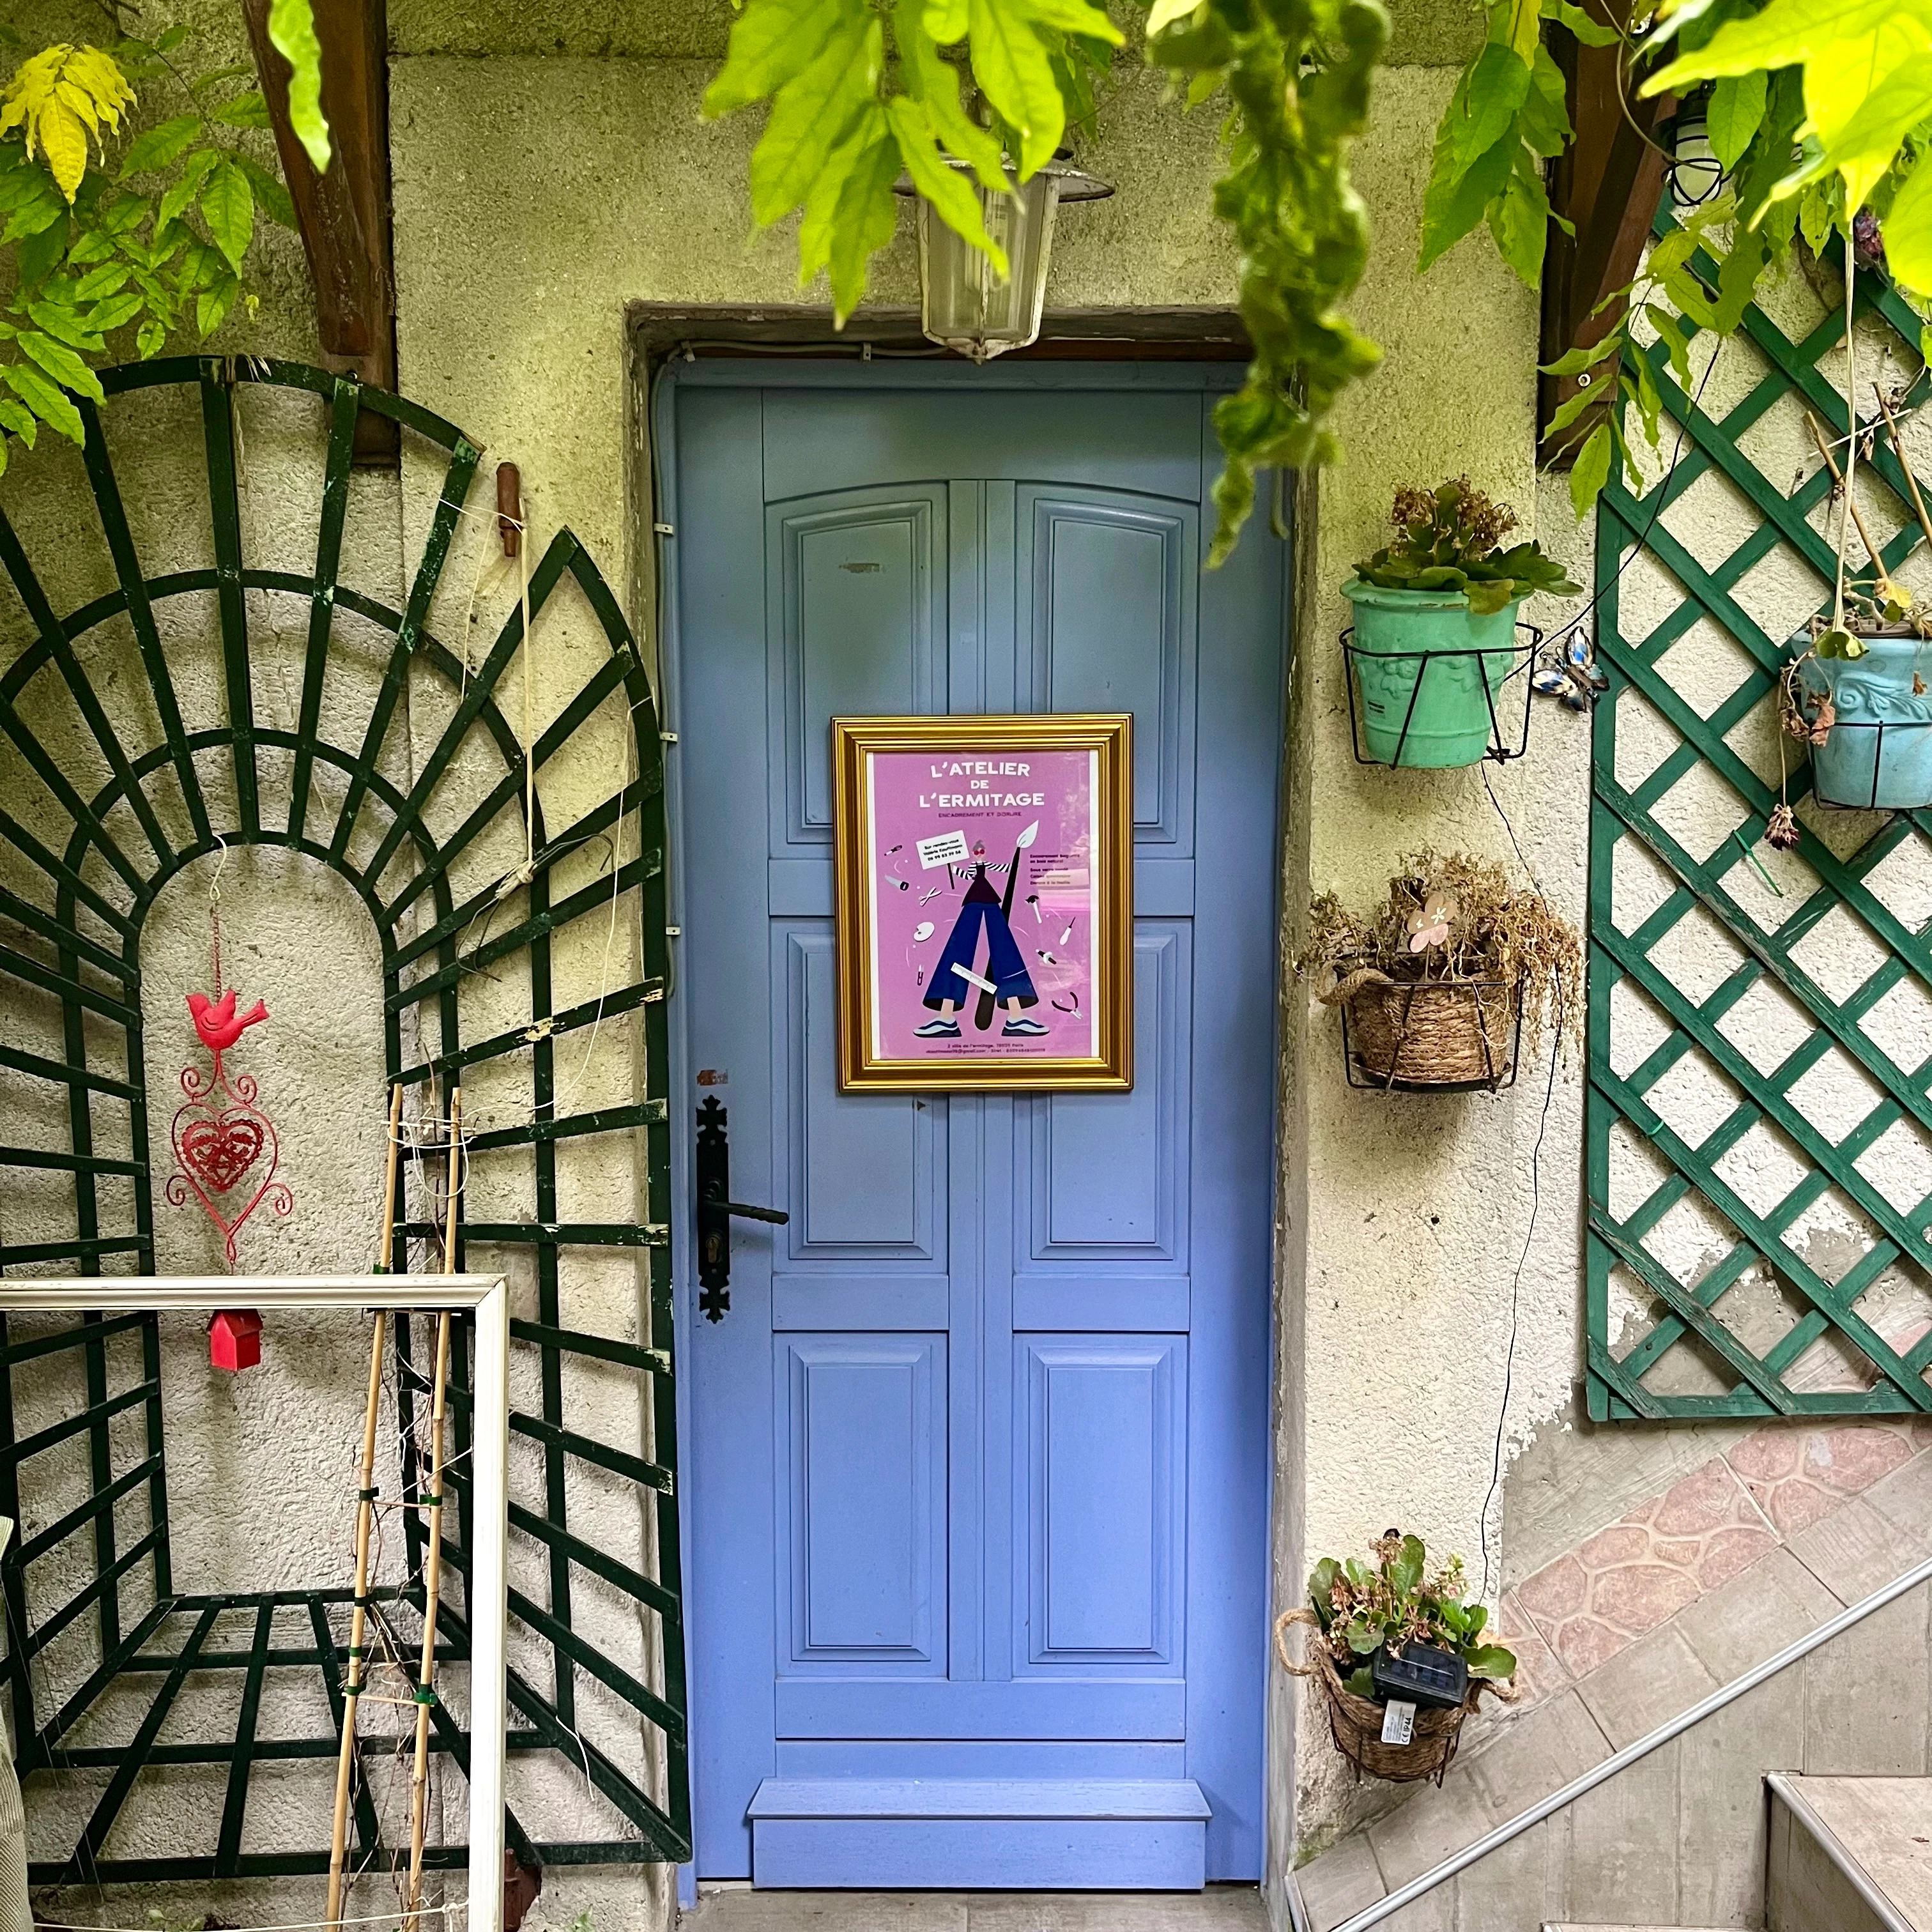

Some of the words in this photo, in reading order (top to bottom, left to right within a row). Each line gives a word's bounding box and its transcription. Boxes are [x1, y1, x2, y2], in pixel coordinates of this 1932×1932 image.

[931, 762, 1031, 778] L'ATELIER
[970, 780, 989, 789] DE
[919, 792, 1045, 808] L'ERMITAGE
